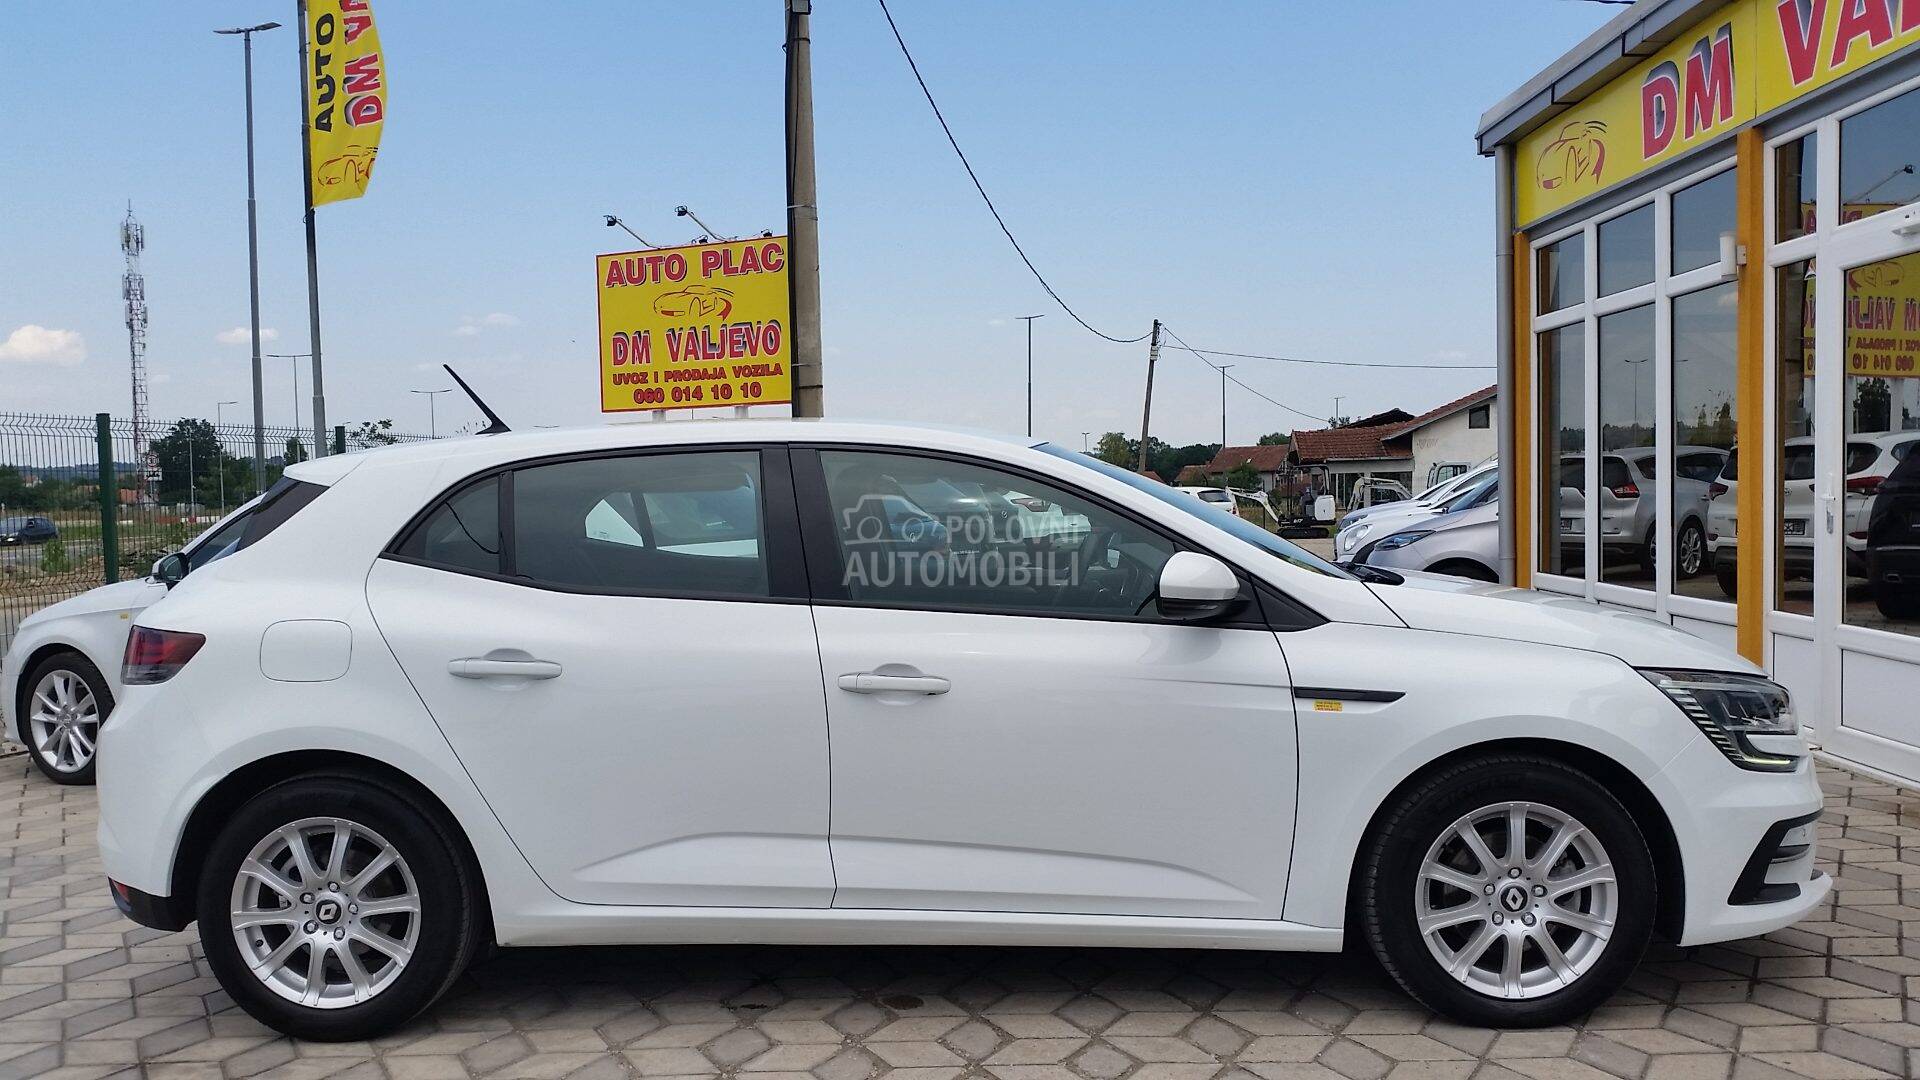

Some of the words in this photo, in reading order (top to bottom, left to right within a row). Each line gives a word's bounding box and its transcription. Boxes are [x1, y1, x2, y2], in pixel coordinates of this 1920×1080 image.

[315, 13, 336, 132] AUTO
[342, 53, 383, 127] DM
[1641, 22, 1735, 160] DM
[606, 253, 687, 287] AUTO
[702, 243, 784, 278] PLAC
[612, 330, 651, 366] DM
[666, 319, 781, 362] VALJEVO
[613, 373, 648, 385] UVOZ
[654, 372, 658, 383] I
[664, 367, 727, 383] PRODAJA
[733, 363, 783, 378] VOZILA
[634, 387, 665, 404] 060
[671, 384, 703, 402] 014
[711, 383, 732, 400] 10
[740, 382, 762, 398] 10
